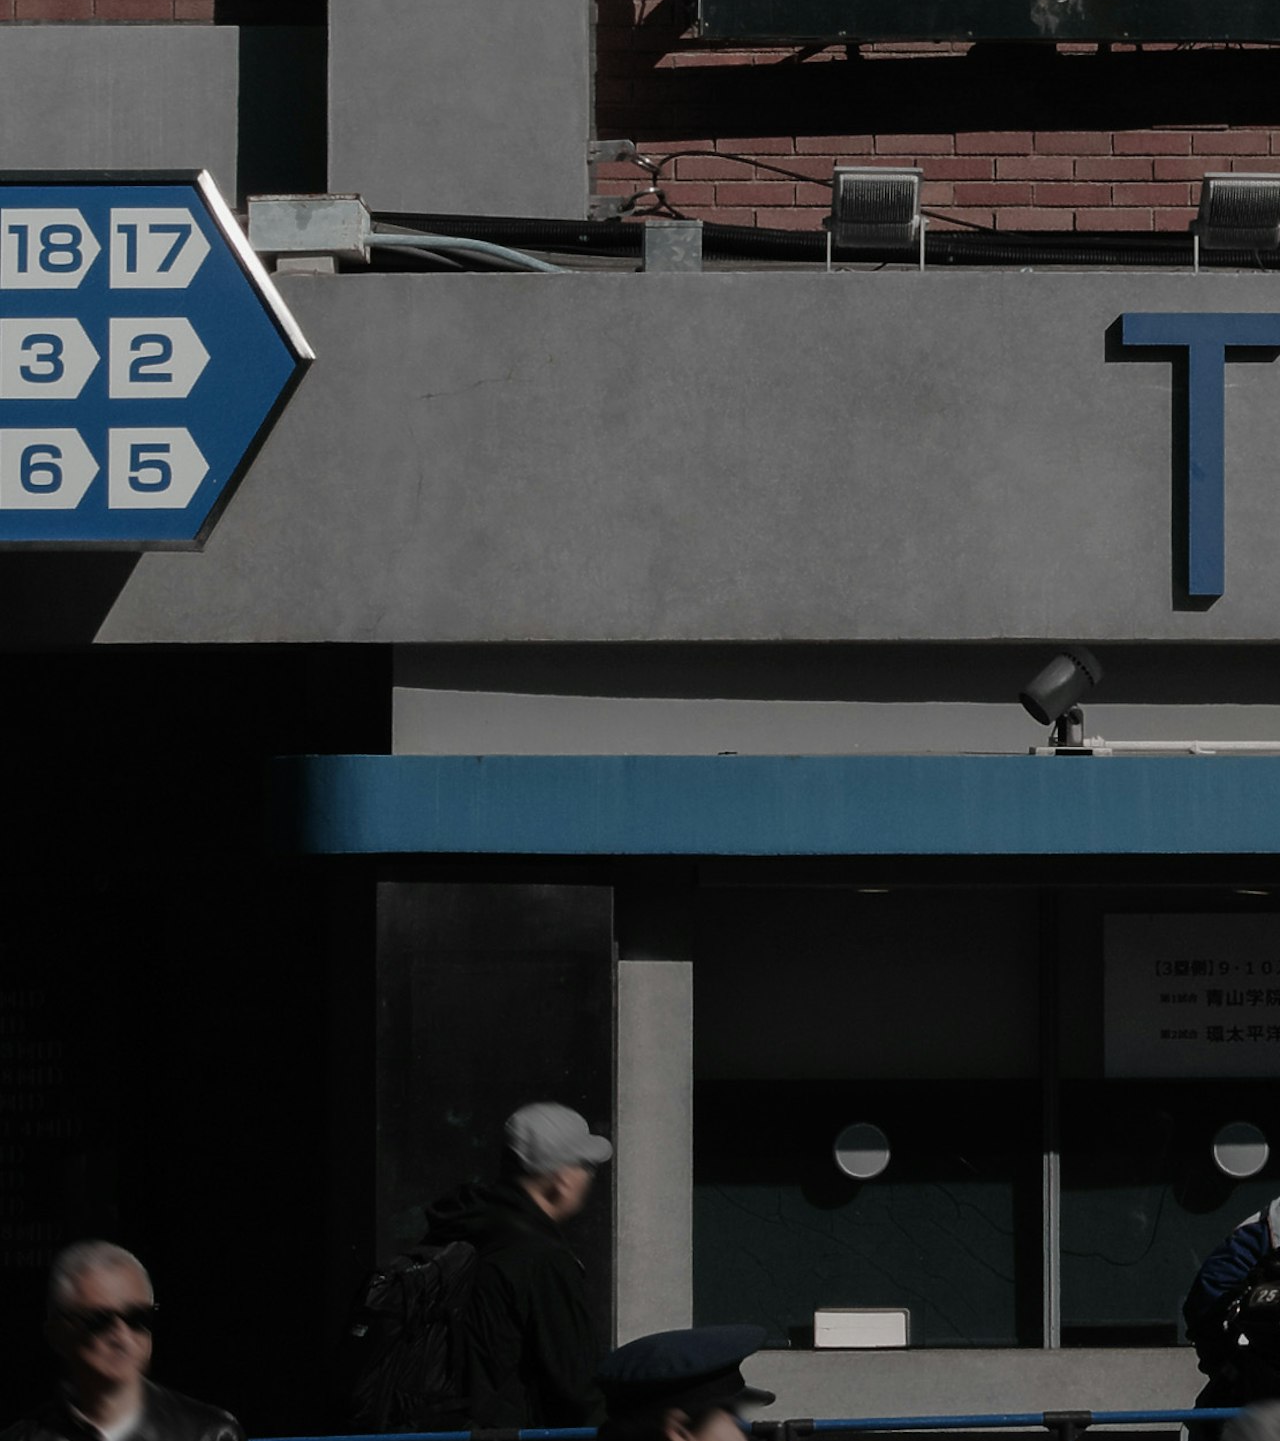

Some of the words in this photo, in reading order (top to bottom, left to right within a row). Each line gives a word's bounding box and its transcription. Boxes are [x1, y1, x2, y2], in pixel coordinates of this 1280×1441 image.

[7, 223, 84, 274] 18
[116, 223, 192, 273] 17
[20, 333, 65, 383] 3
[129, 333, 173, 383] 2
[19, 443, 63, 494] 6
[127, 443, 173, 493] 5
